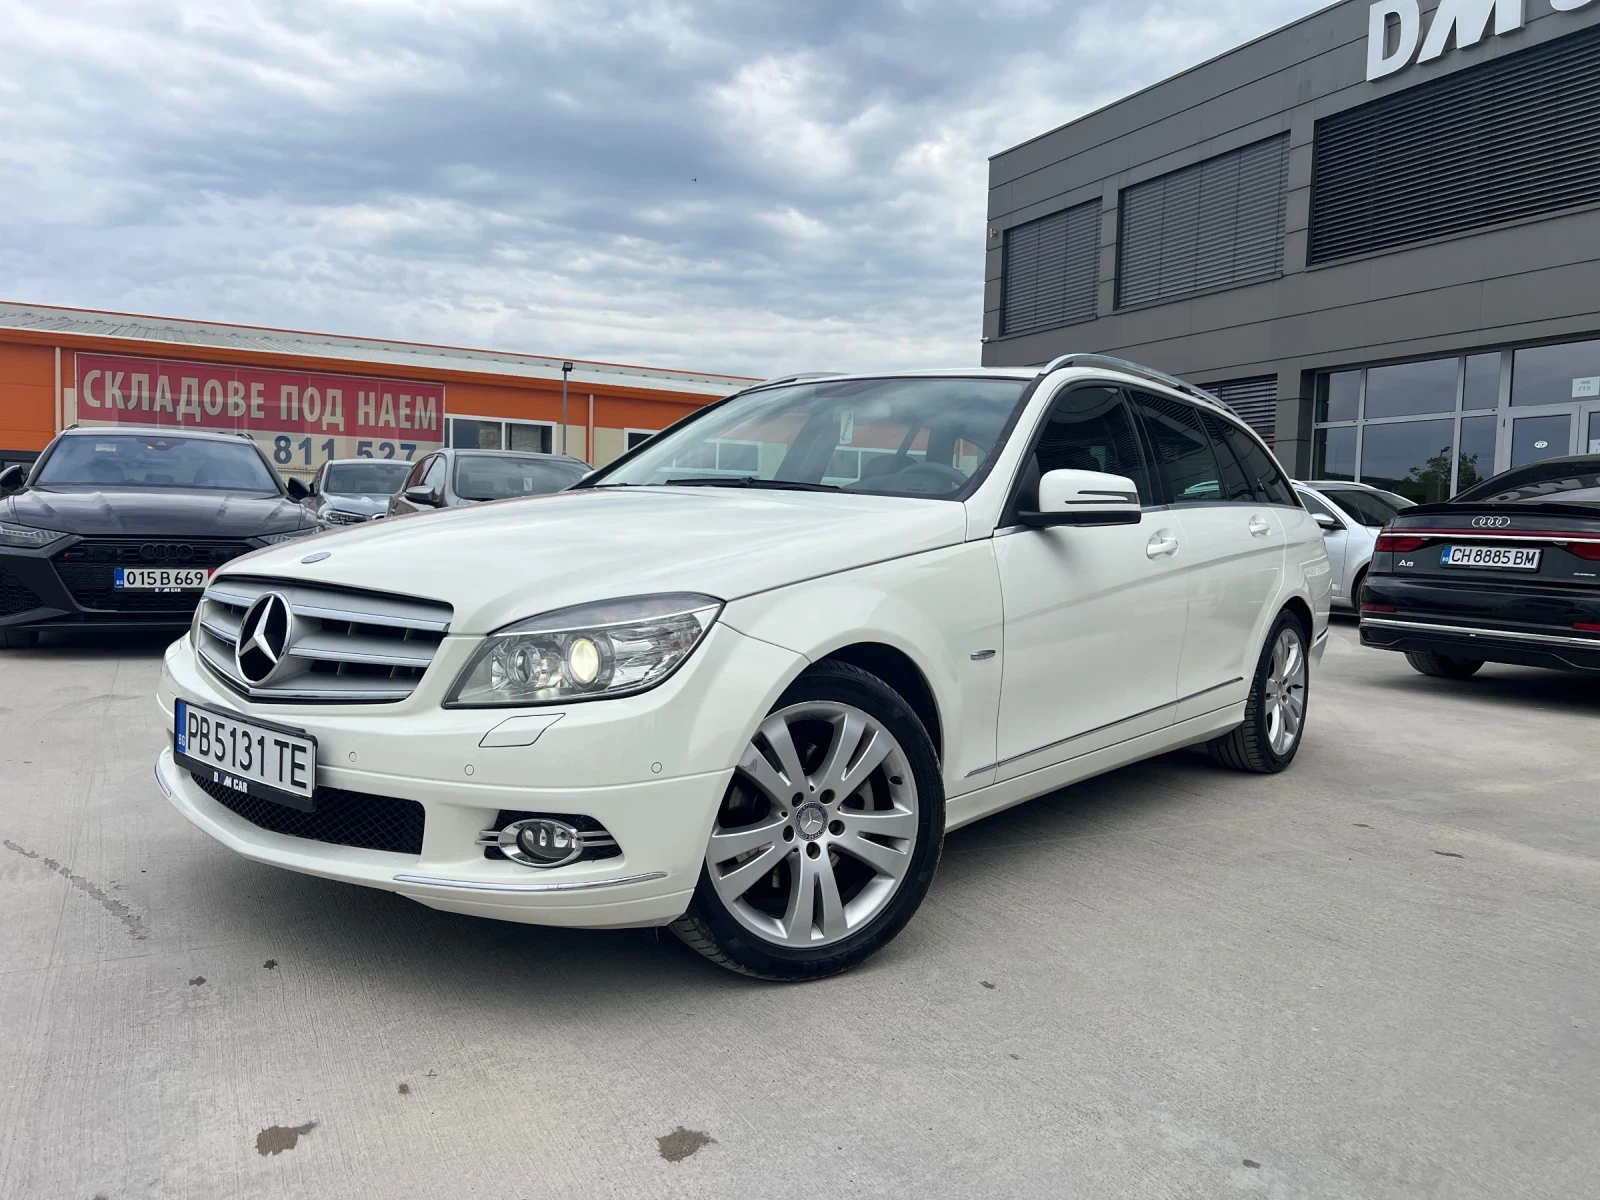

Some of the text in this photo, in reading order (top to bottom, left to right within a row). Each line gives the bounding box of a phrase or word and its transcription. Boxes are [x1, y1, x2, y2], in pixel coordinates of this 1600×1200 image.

[83, 369, 437, 432] СКЛАДОВЕ ПОД НАЕМ
[273, 435, 417, 465] 811 527
[233, 779, 248, 794] CAR
